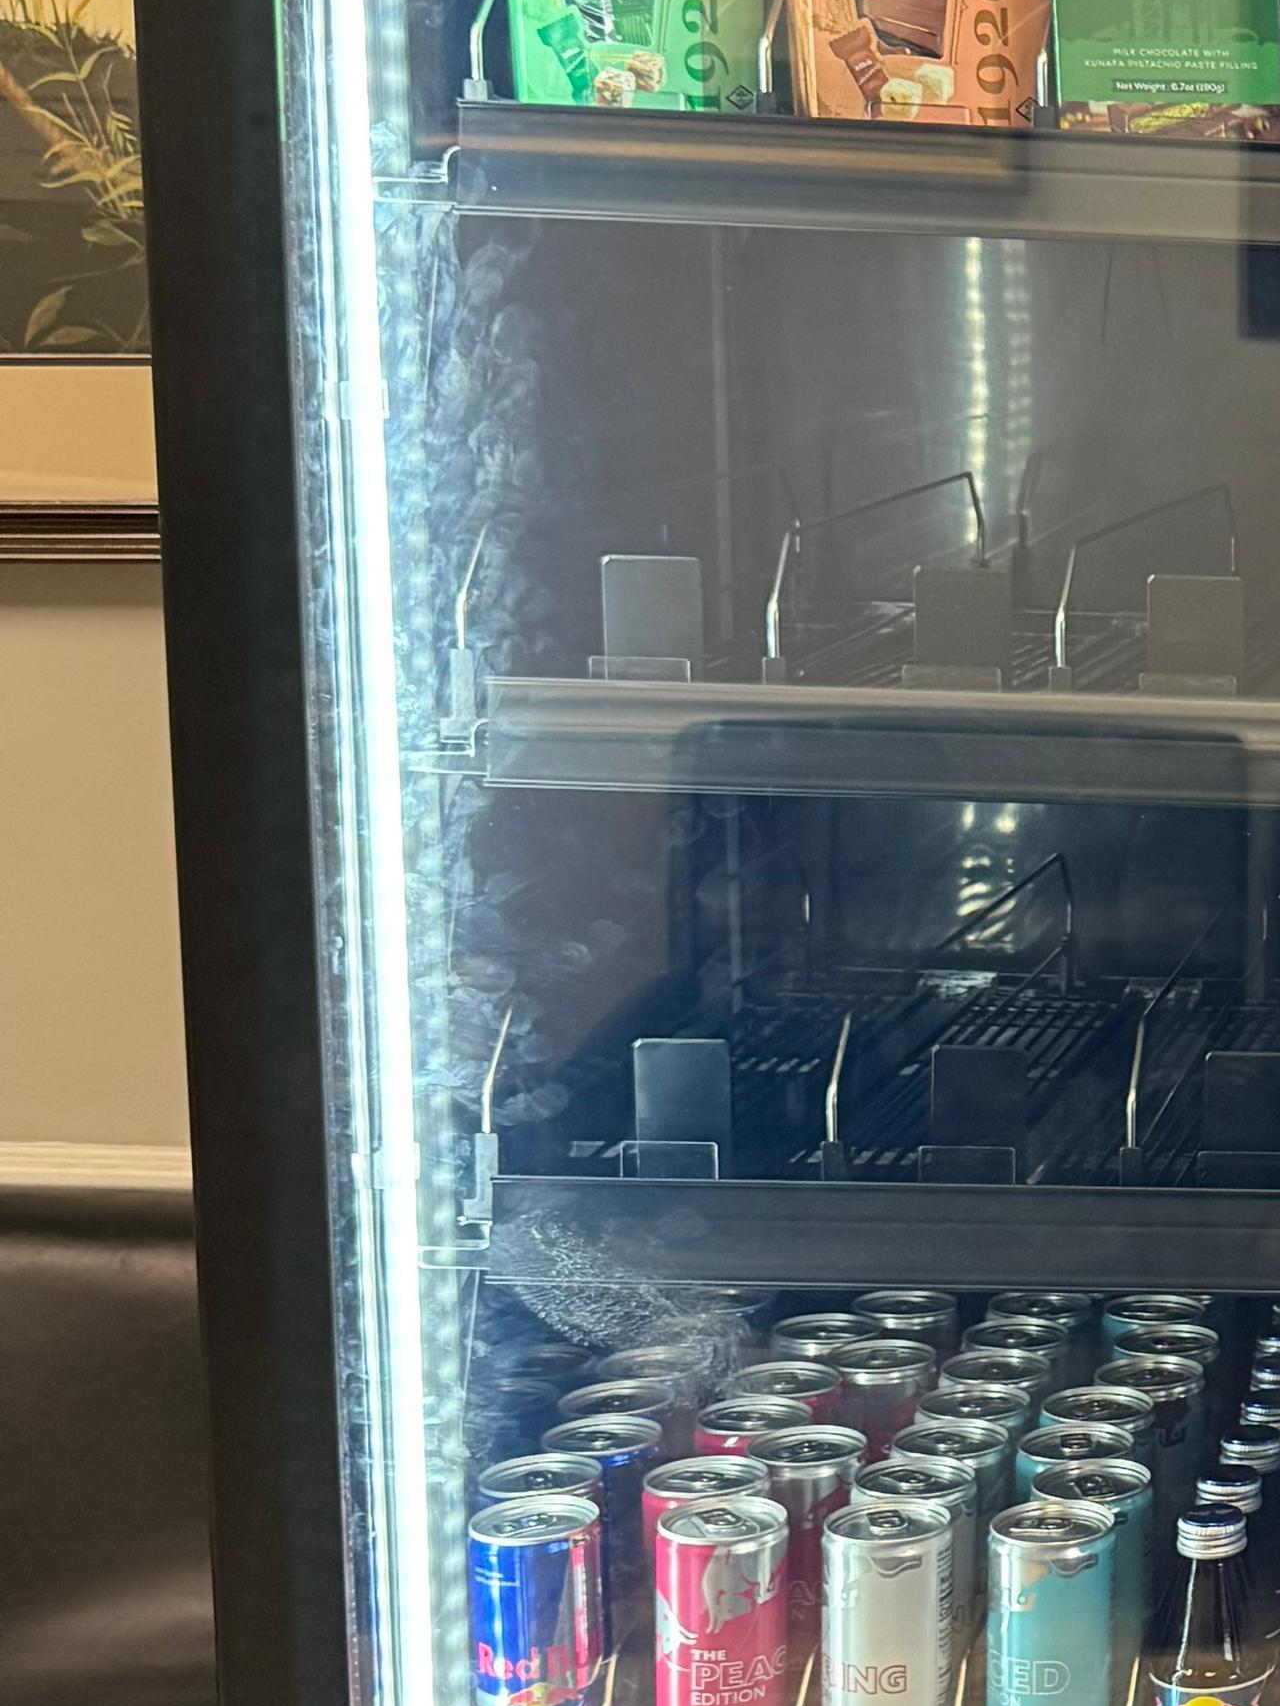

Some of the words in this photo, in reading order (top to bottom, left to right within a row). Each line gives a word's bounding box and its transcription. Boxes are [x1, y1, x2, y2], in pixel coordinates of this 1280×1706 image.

[477, 1643, 541, 1681] Red
[691, 1645, 787, 1691] PEAC
[692, 1649, 726, 1662] THE
[691, 1685, 766, 1706] EDITION
